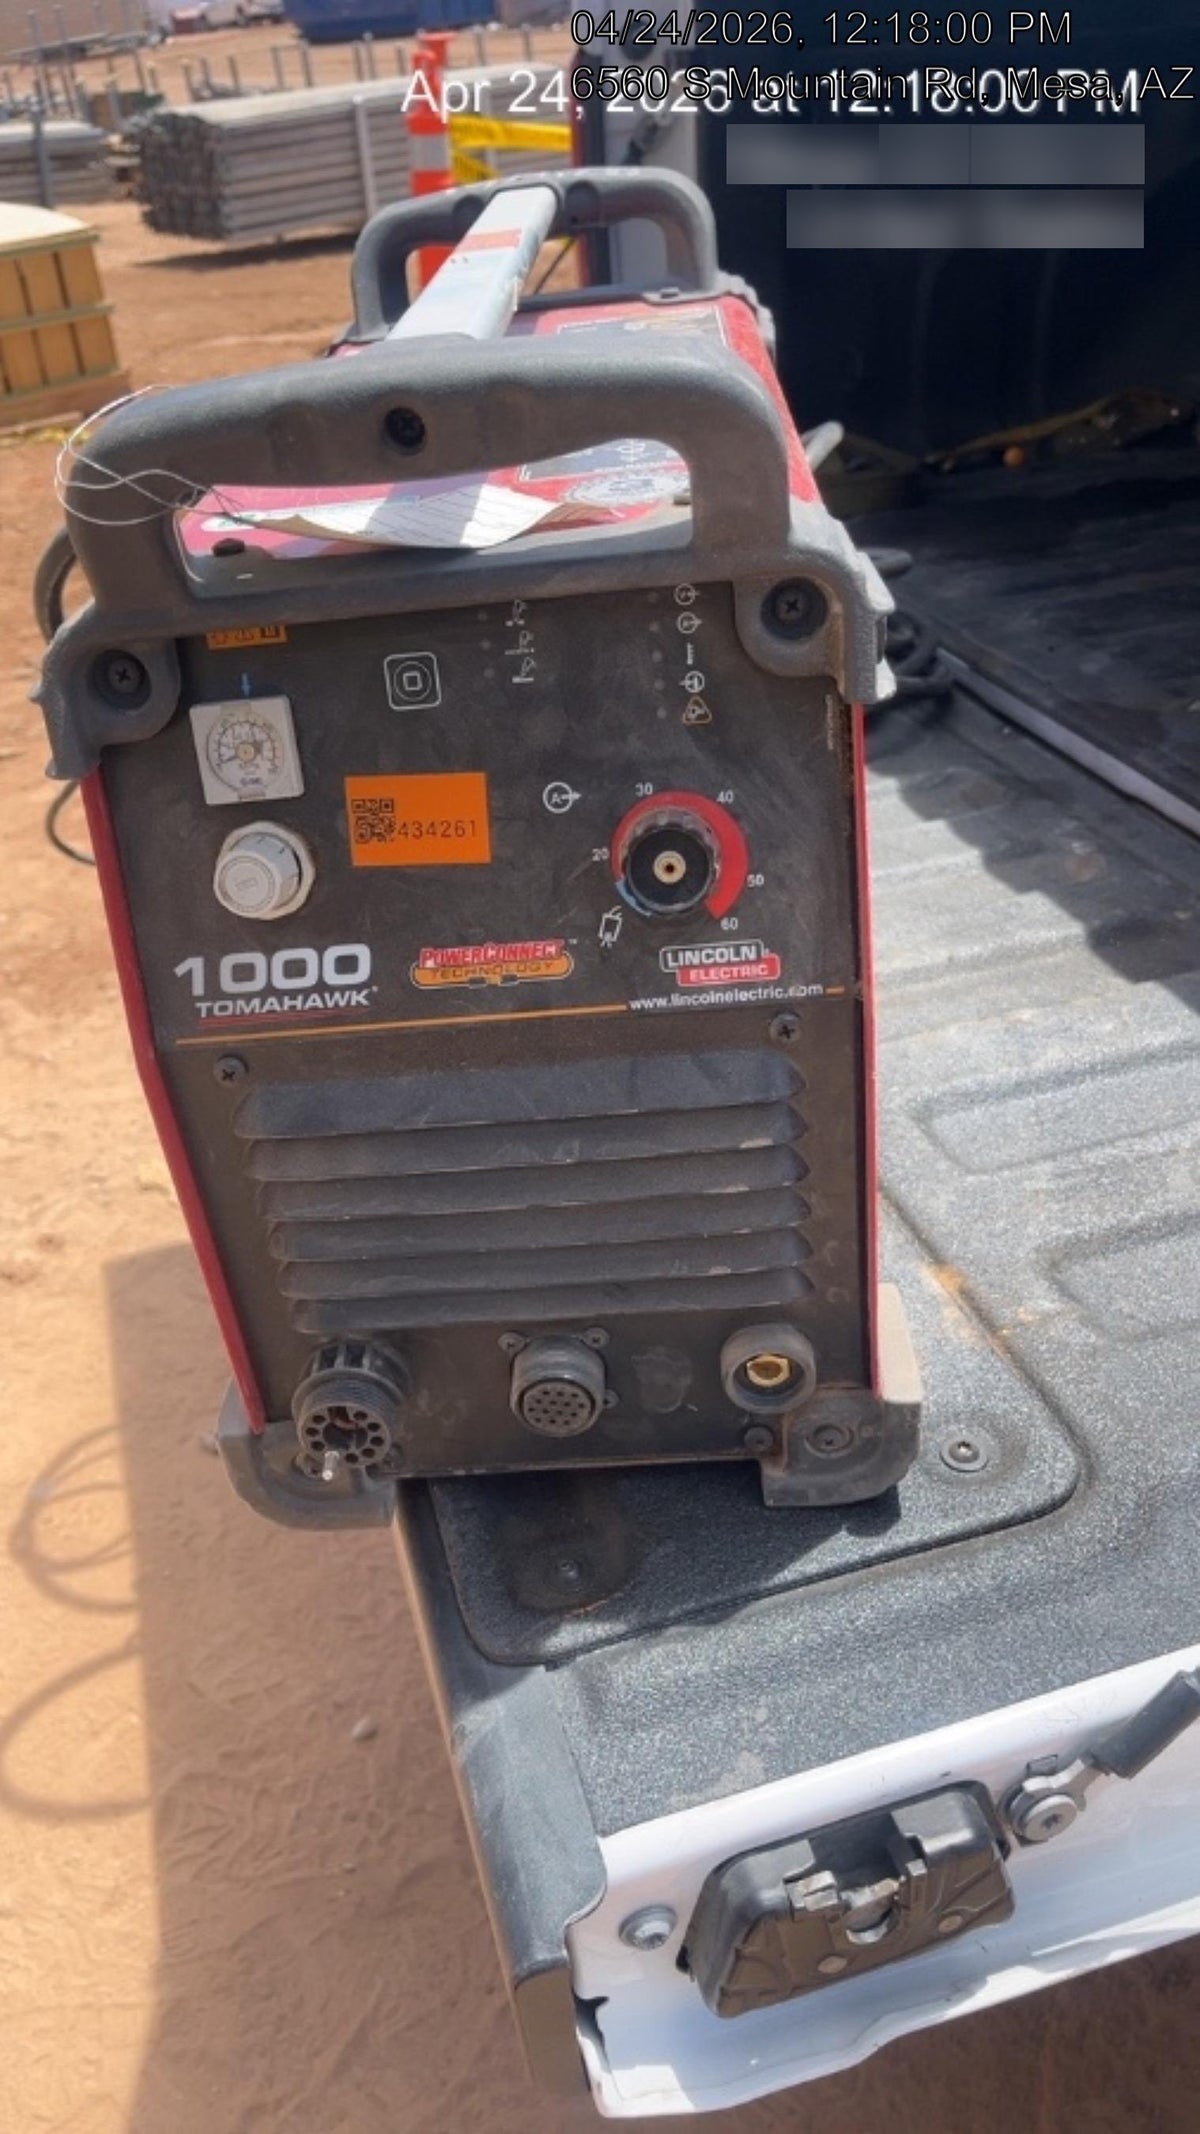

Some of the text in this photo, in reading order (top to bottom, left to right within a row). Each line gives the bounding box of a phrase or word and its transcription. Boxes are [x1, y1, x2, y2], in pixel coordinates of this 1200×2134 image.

[635, 783, 653, 796] 30
[717, 789, 734, 804] 40
[397, 819, 477, 840] 434261
[592, 848, 609, 861] 20
[747, 873, 765, 888] 50
[721, 916, 738, 931] 60
[666, 945, 758, 967] LINCOLN
[173, 943, 371, 996] 1000
[689, 964, 768, 982] ELECTRIC
[196, 988, 370, 1019] TOMAHAWK
[630, 984, 823, 1009] www.lincolnelectric.com
